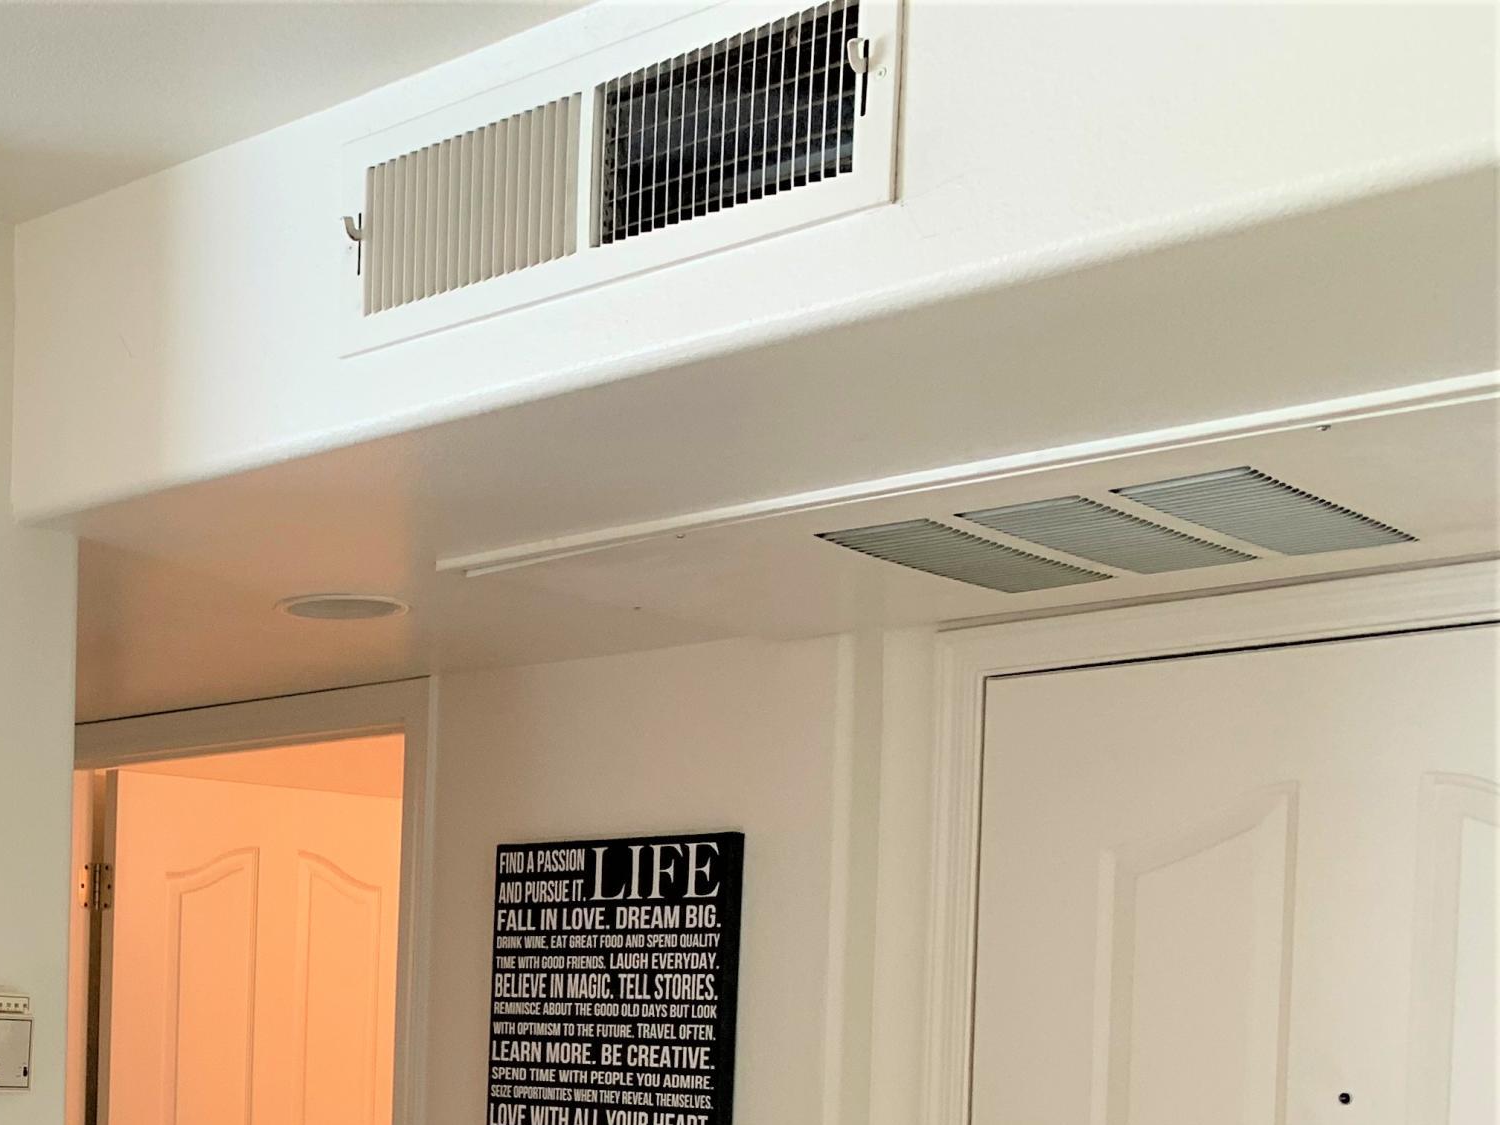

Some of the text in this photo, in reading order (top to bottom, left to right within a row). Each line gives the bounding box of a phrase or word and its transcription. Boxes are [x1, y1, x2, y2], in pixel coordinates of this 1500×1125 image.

[499, 848, 585, 873] FIND A PASSION
[590, 841, 719, 900] LIFE
[498, 878, 586, 903] AND PURSUE IT.
[497, 904, 721, 931] FALL IN LOVE. DREAM BIG.
[496, 936, 522, 948] DRINK
[550, 935, 567, 948] EAT
[569, 934, 598, 948] GREAT
[599, 934, 623, 948] FOOD
[625, 934, 644, 948] AND
[646, 933, 677, 947] SPEND
[679, 933, 720, 948] QUALITY
[496, 952, 719, 969] TIME WITH GOOD FRIENDS. LAUGH EVERYDAY.
[494, 972, 718, 1000] BELIEVE IN MAGIC. TELL STORIES.
[493, 1001, 717, 1018] REMINISCE ABOUT THE GOOD OLD DAYS BUT LOOK
[493, 1021, 715, 1040] WITH OPTIMISM TO THE FUTURE. TRAVEL OFTEN.
[491, 1040, 714, 1069] LEARN MORE. BE CREATIVE.
[491, 1066, 714, 1090] SPEND TIME WITH PEOPLE YOU ADMIRE.
[490, 1084, 713, 1109] SEIZE OPPORTUNITIES WHEN THEY REVEAL THEMSELVES.
